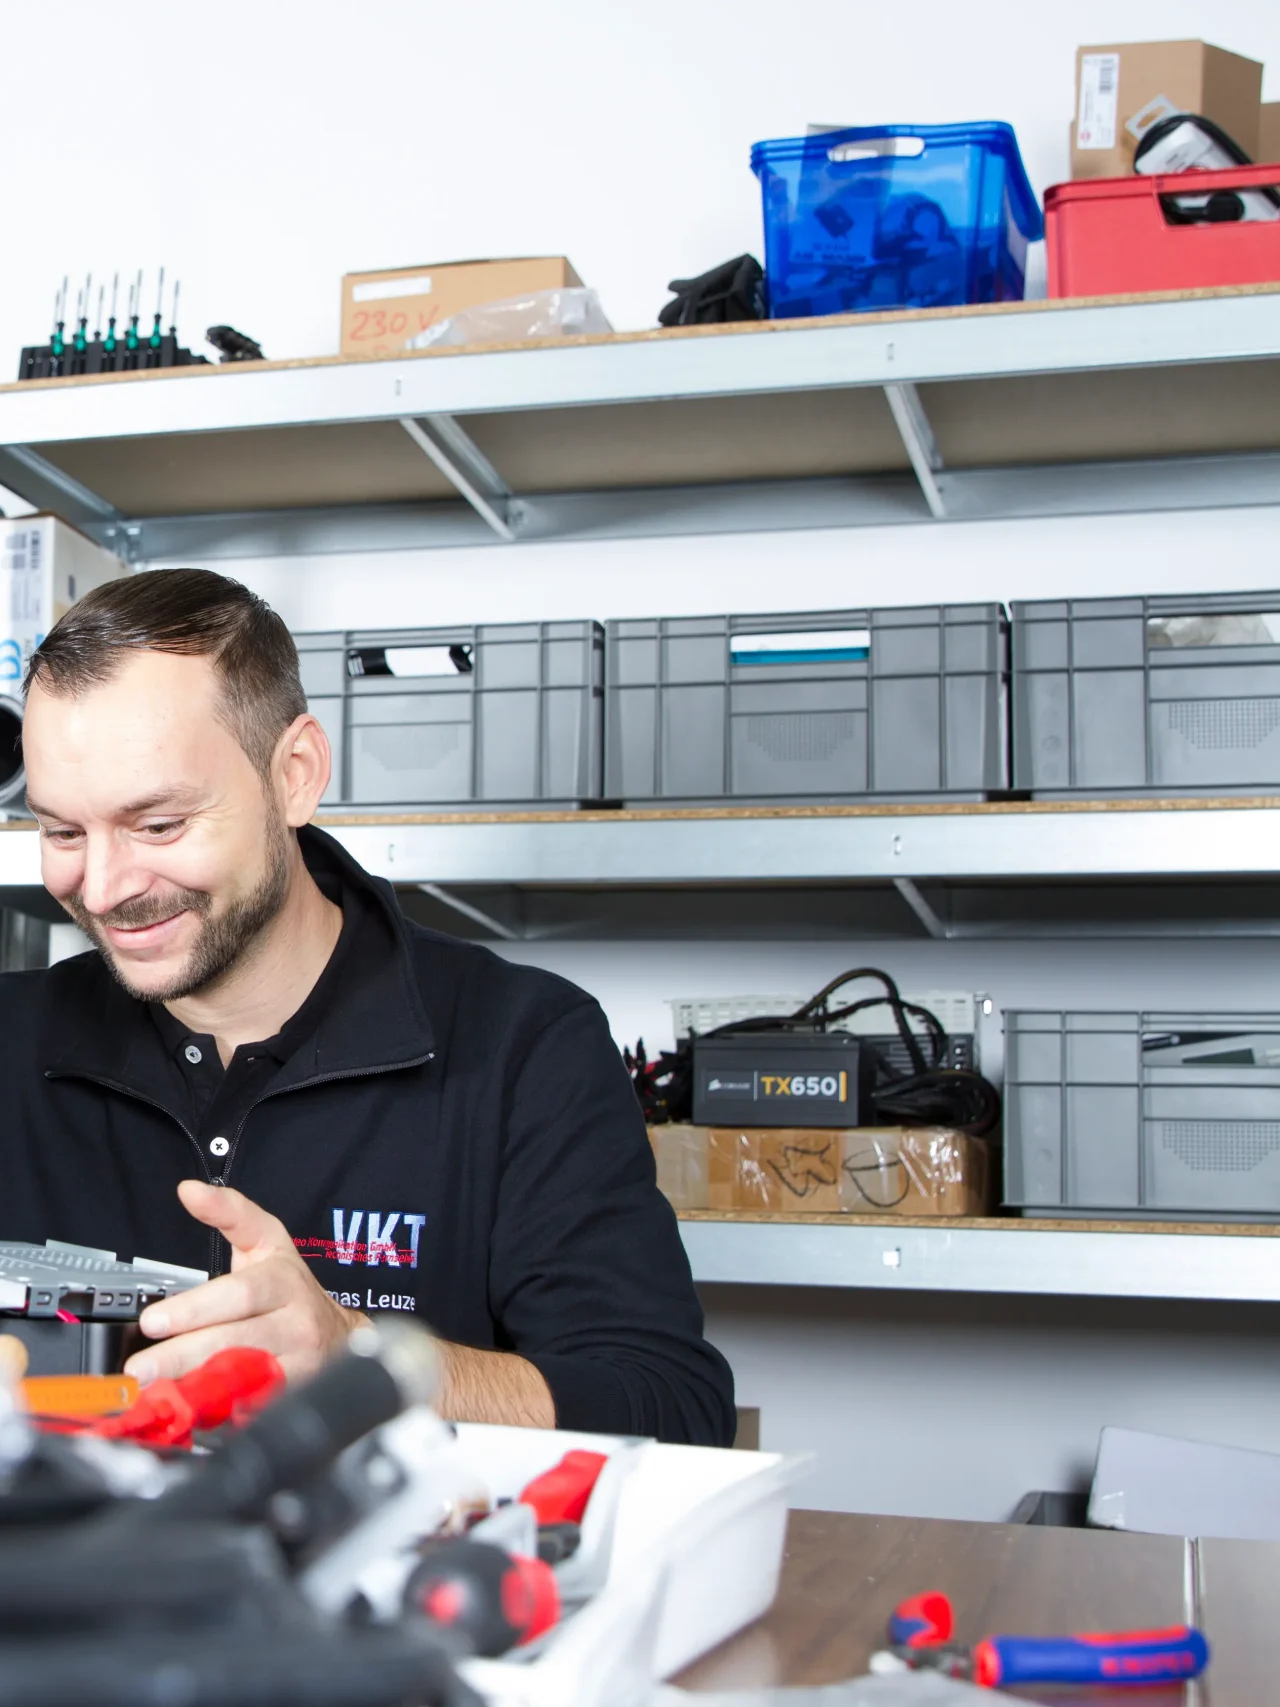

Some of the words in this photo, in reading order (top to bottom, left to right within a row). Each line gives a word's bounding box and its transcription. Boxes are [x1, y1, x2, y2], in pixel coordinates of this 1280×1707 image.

[349, 310, 408, 341] 230
[761, 1076, 838, 1096] TX650
[332, 1209, 426, 1268] VKT
[325, 1290, 361, 1308] mas
[366, 1288, 416, 1311] Leuze
